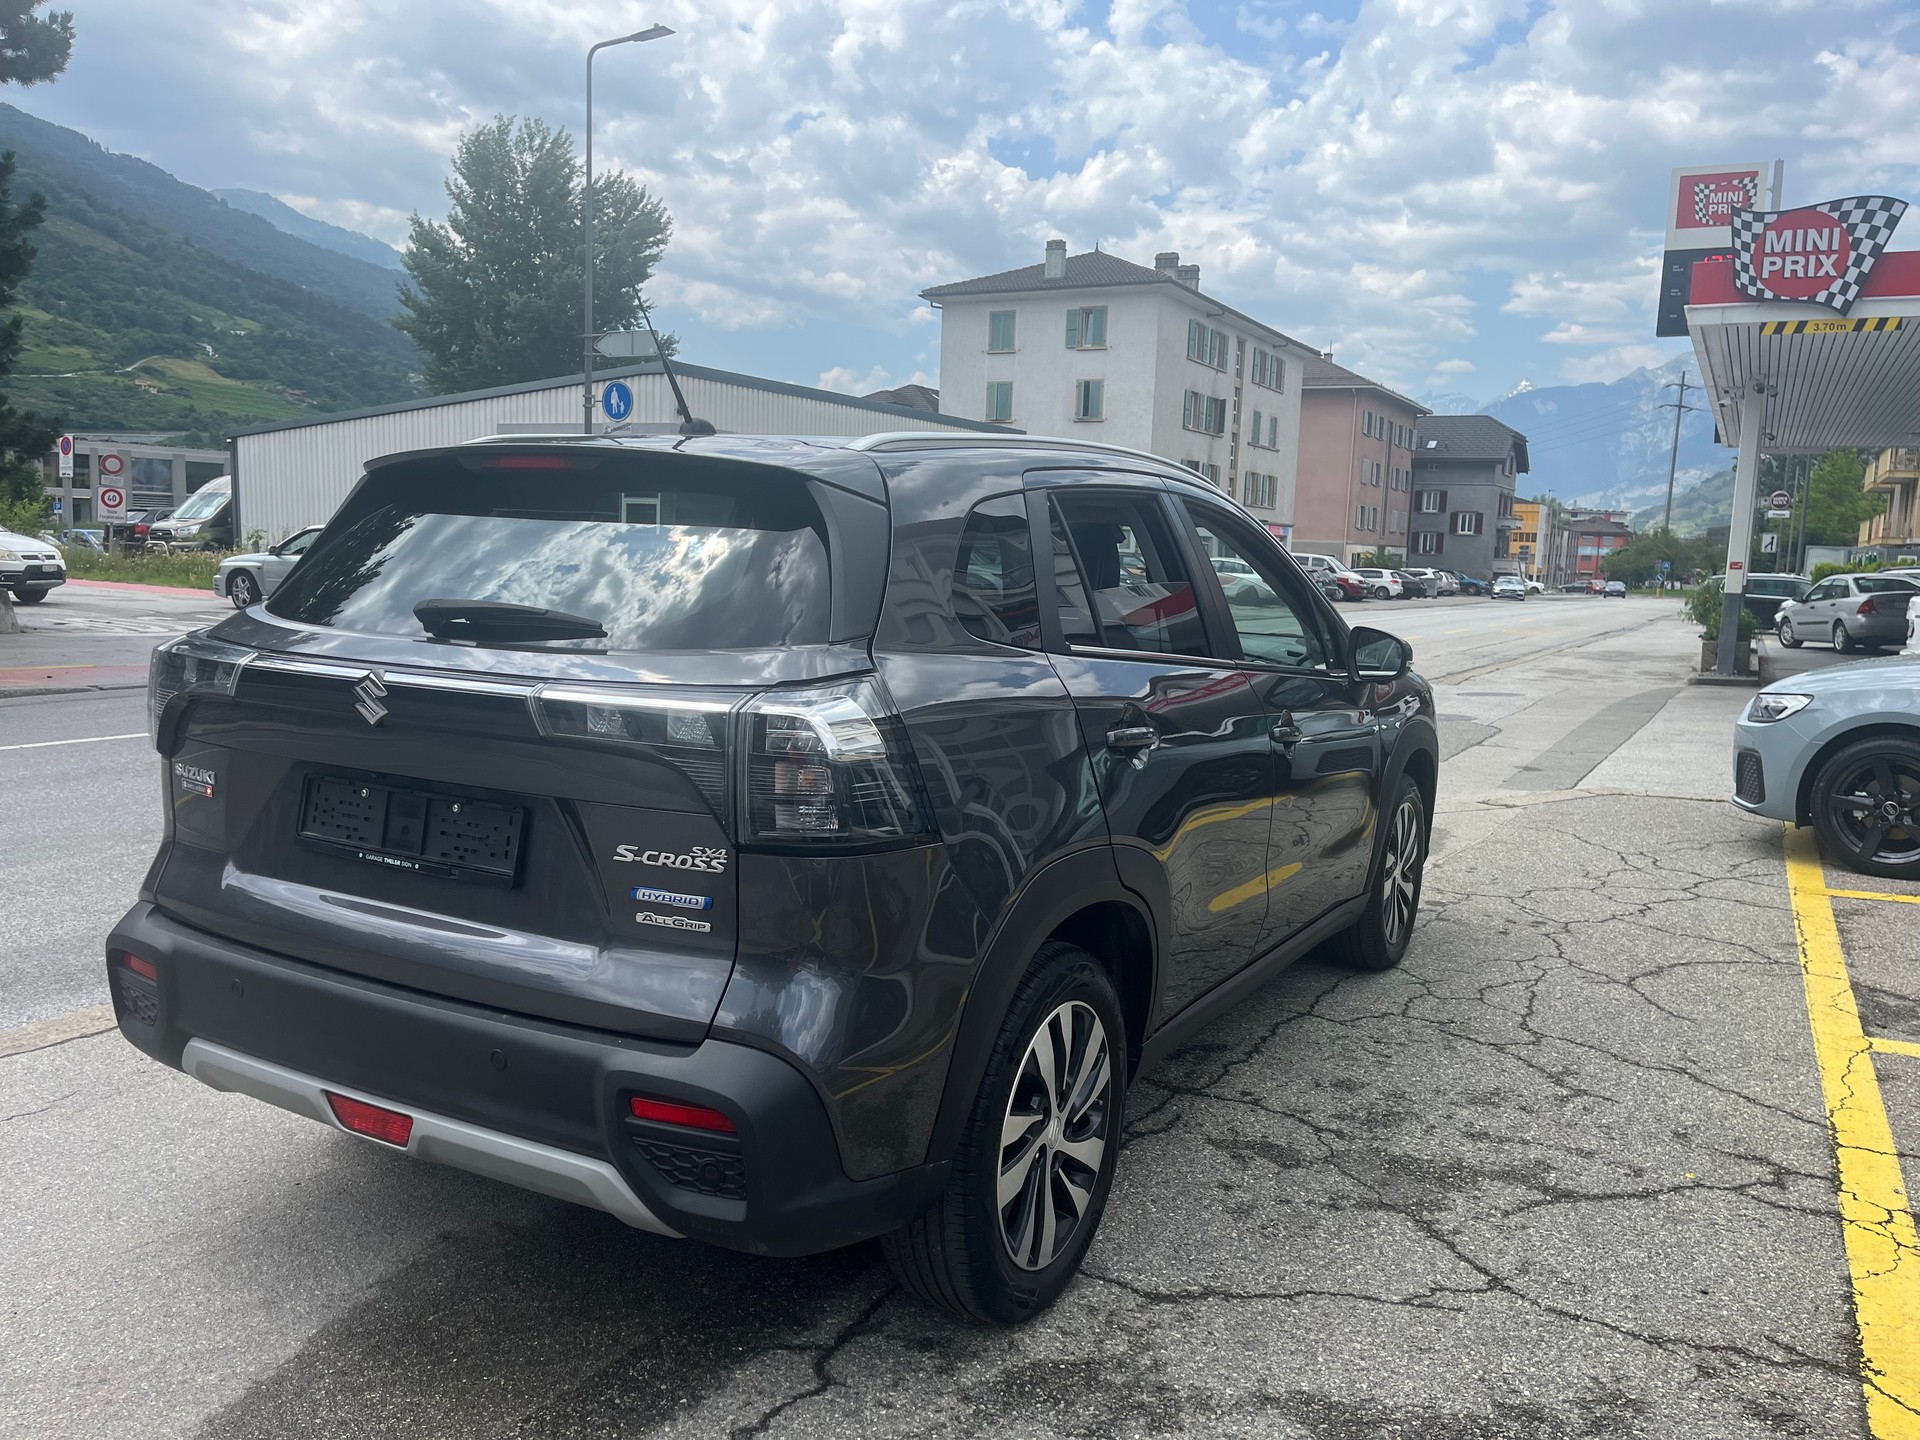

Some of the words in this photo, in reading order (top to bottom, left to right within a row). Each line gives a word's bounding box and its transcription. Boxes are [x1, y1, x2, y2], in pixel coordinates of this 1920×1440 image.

[1709, 191, 1743, 204] MINI
[1764, 227, 1841, 254] MINI
[1761, 254, 1839, 279] PRIX
[107, 494, 117, 502] 40
[174, 761, 216, 785] SUZUKI
[365, 853, 383, 863] GARAGE
[613, 844, 727, 873] S-CROSS
[689, 846, 728, 860] SX4
[641, 891, 700, 908] HYBRID
